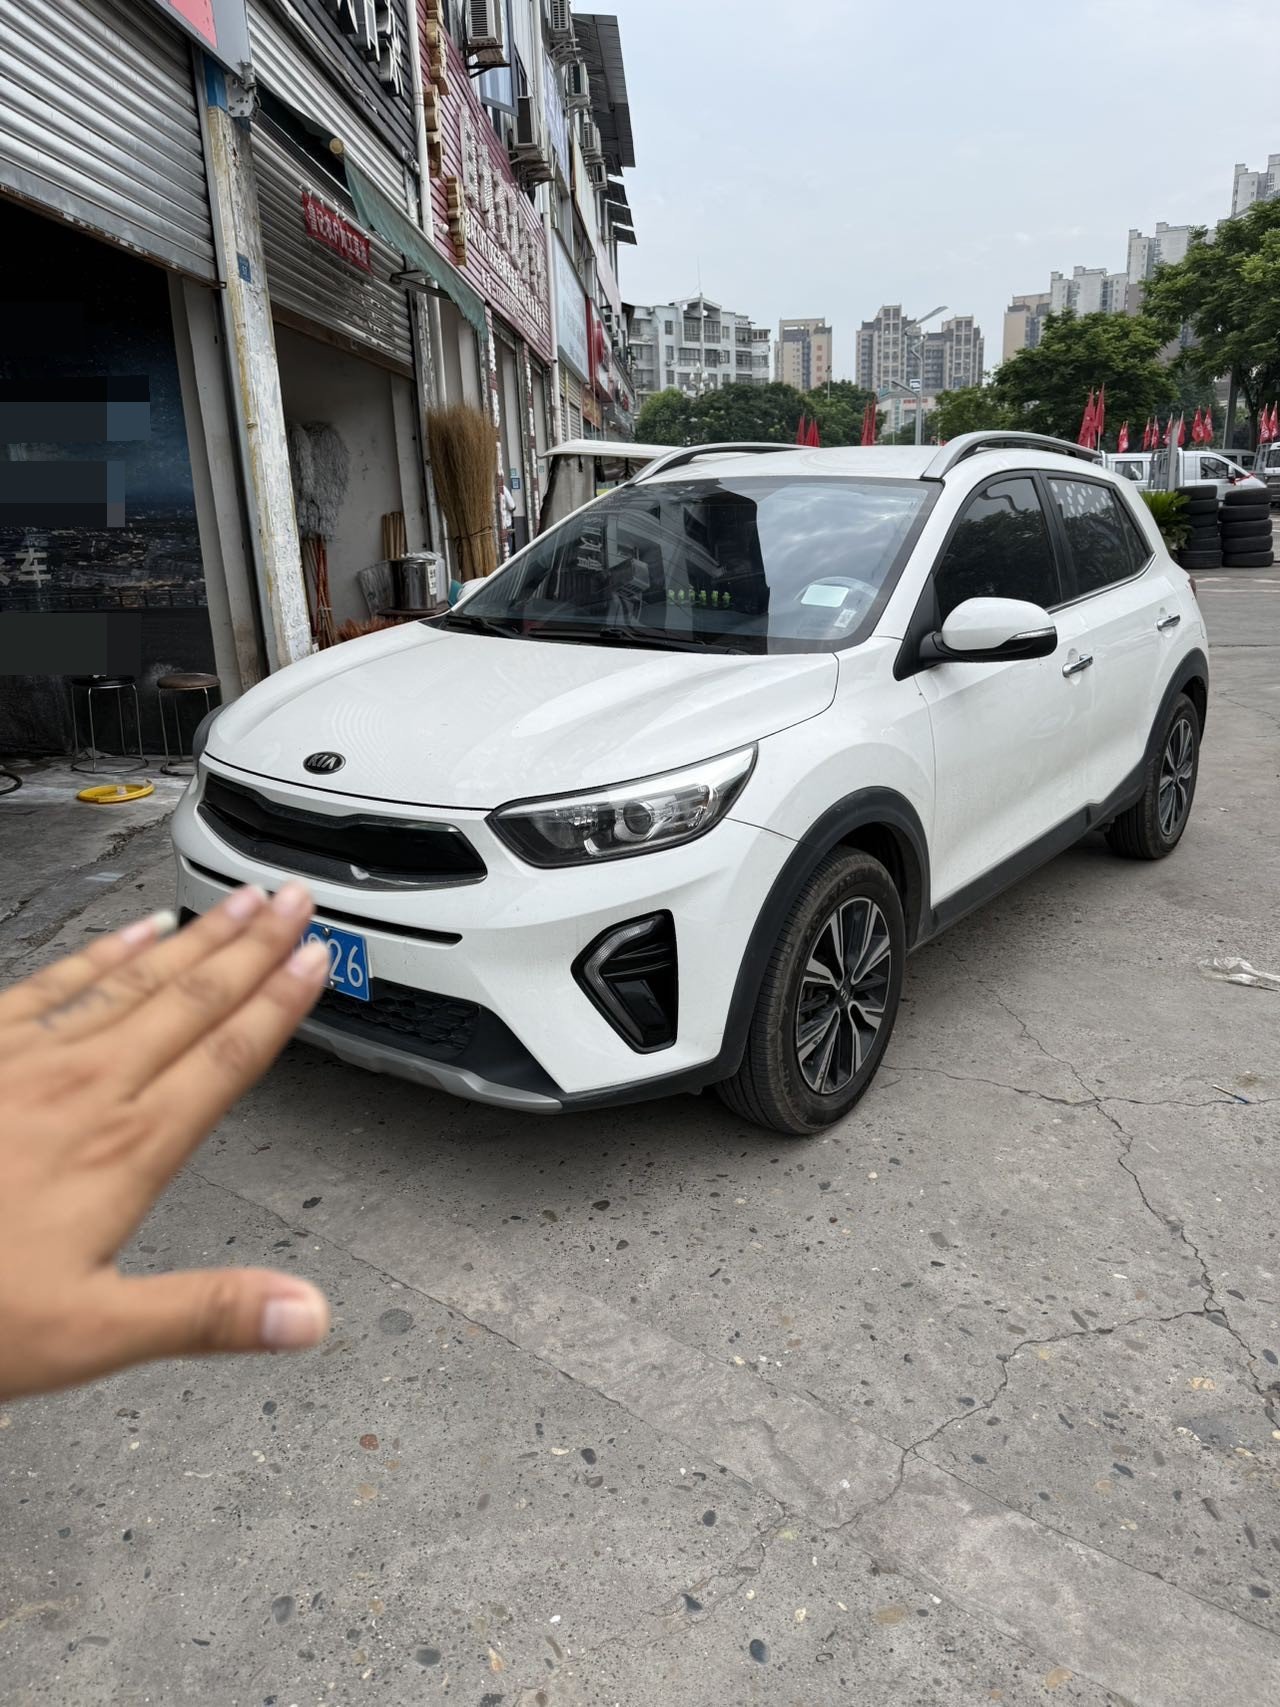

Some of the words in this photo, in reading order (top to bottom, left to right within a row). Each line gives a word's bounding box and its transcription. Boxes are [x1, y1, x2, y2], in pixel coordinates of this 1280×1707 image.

[0, 548, 51, 588] 车
[307, 754, 338, 770] KIA
[301, 932, 363, 988] 26
